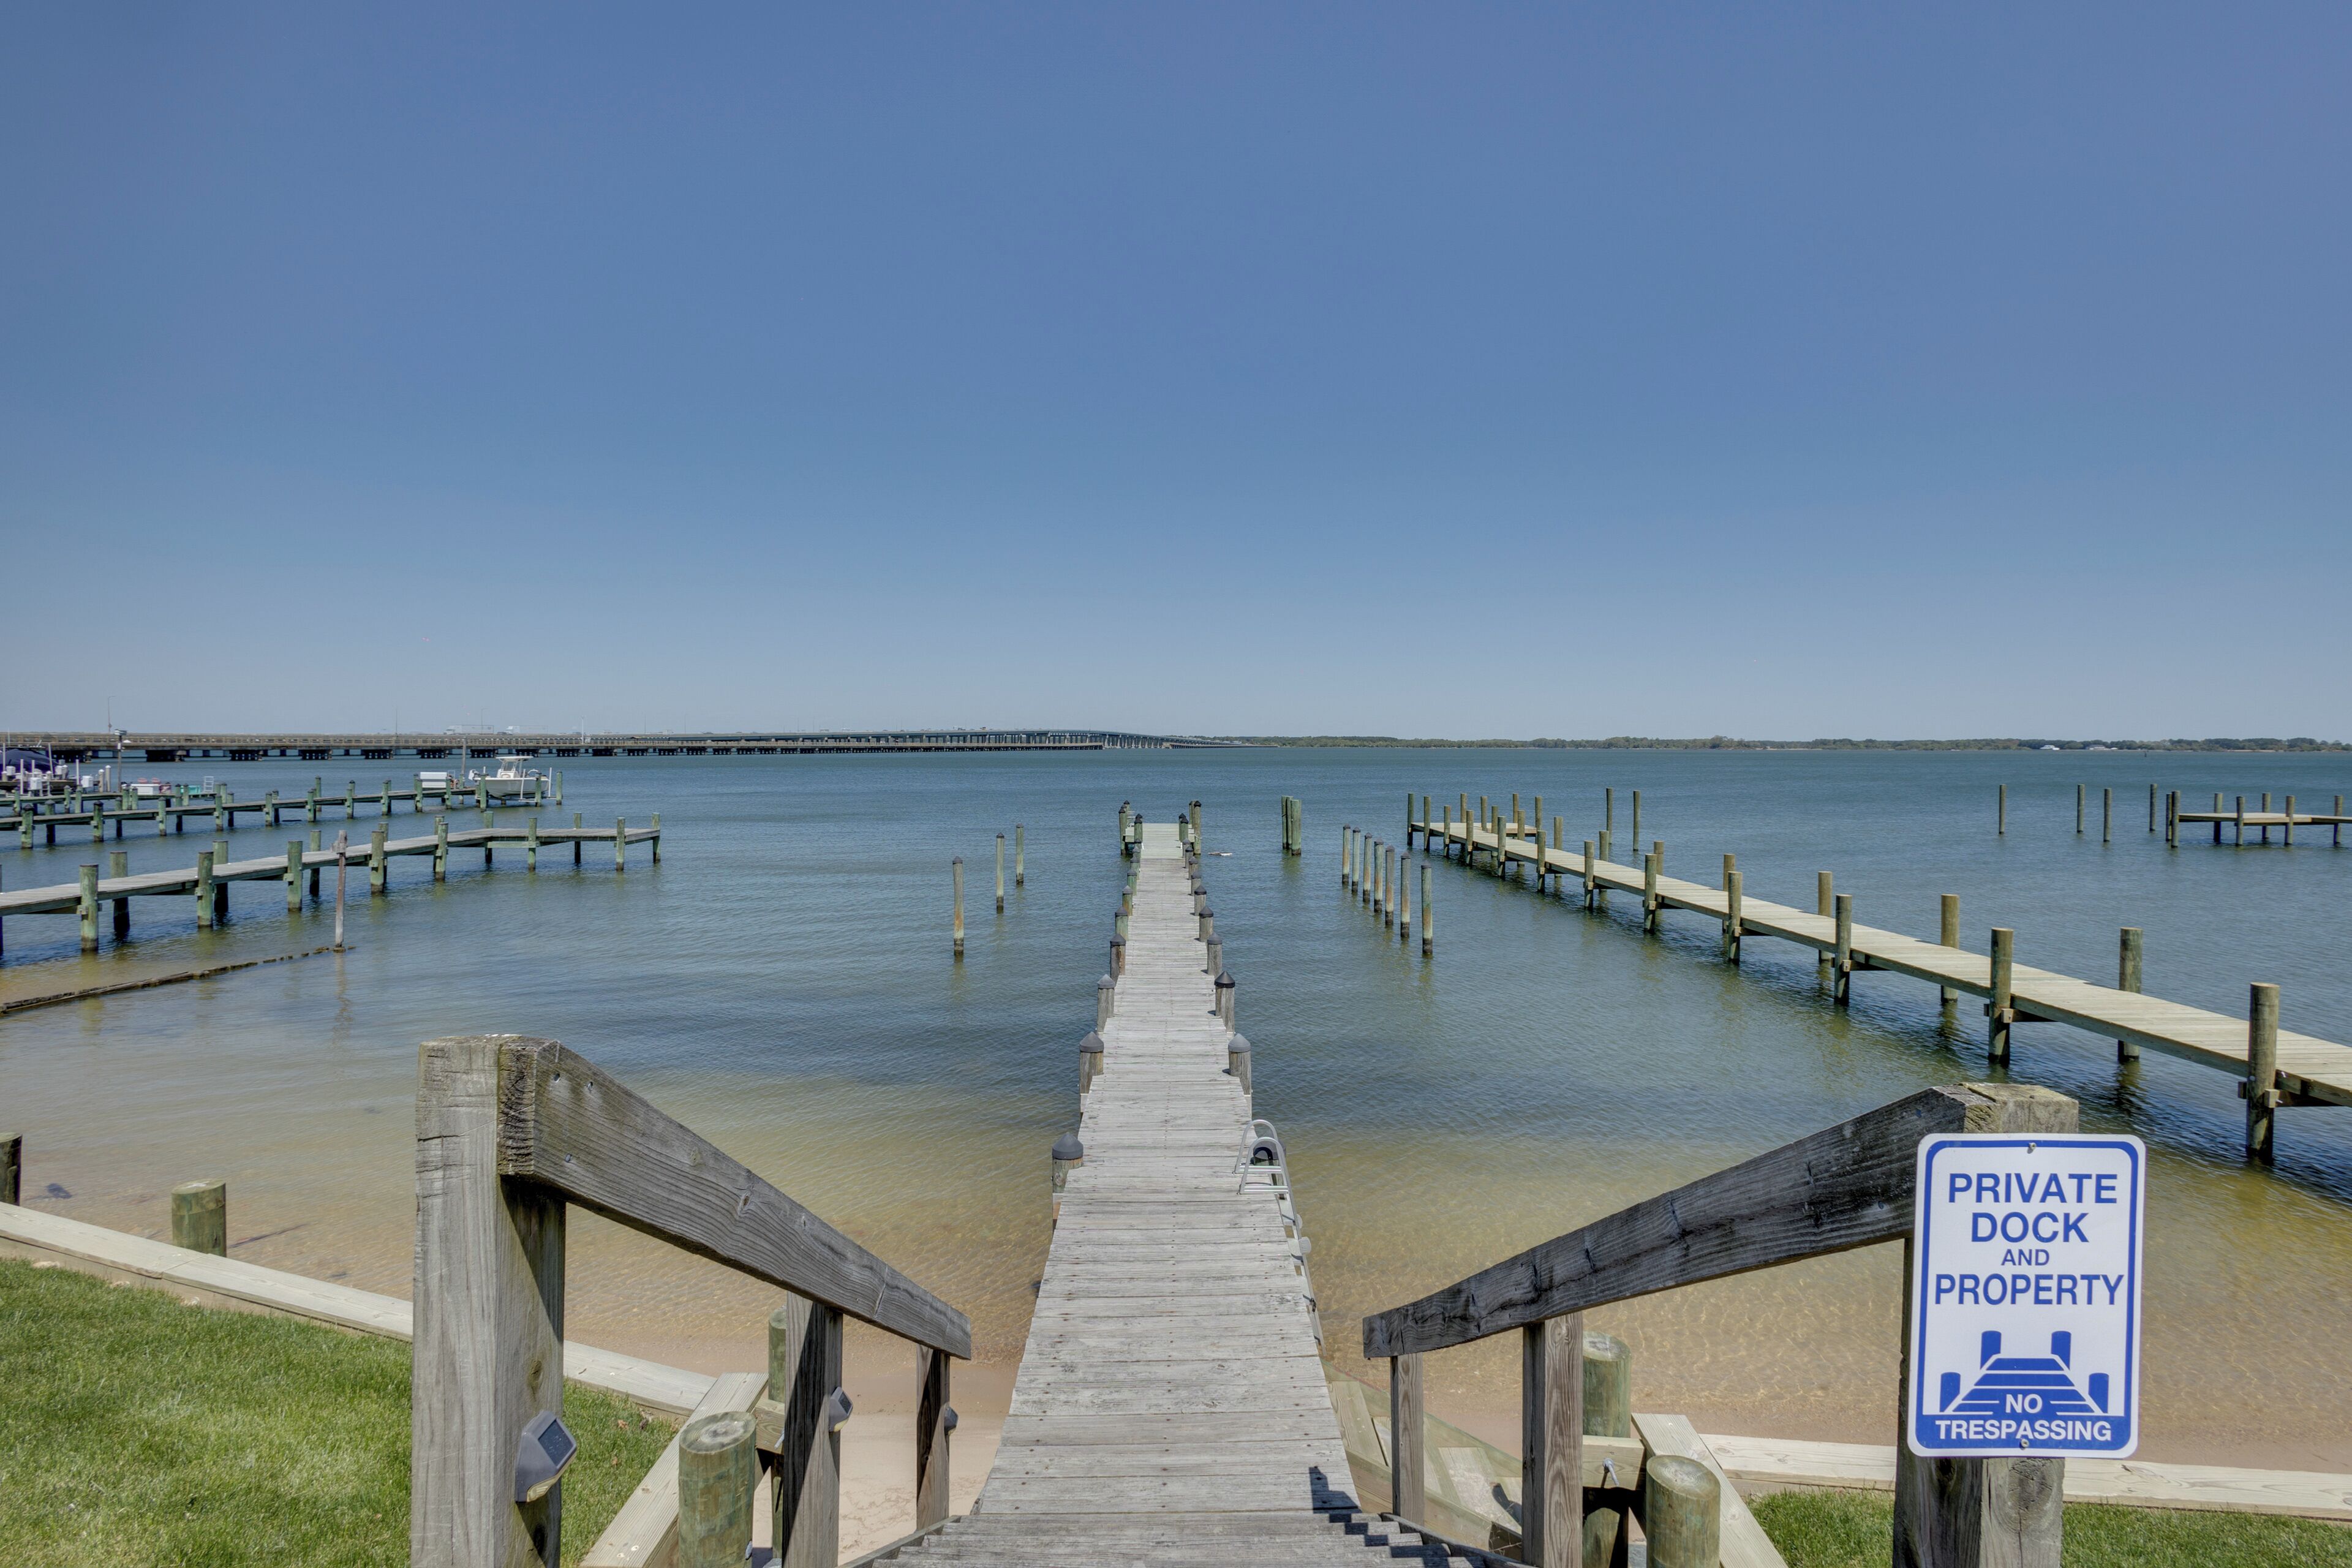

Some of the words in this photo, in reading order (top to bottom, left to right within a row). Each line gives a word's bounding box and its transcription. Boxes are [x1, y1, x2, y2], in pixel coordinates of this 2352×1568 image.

[1949, 1173, 2117, 1204] PRIVATE
[1972, 1212, 2089, 1243] DOCK
[2001, 1249, 2049, 1265] AND
[1936, 1273, 2124, 1305] PROPERTY
[2005, 1394, 2043, 1414] NO
[1936, 1420, 2111, 1441] TRESPASSING
